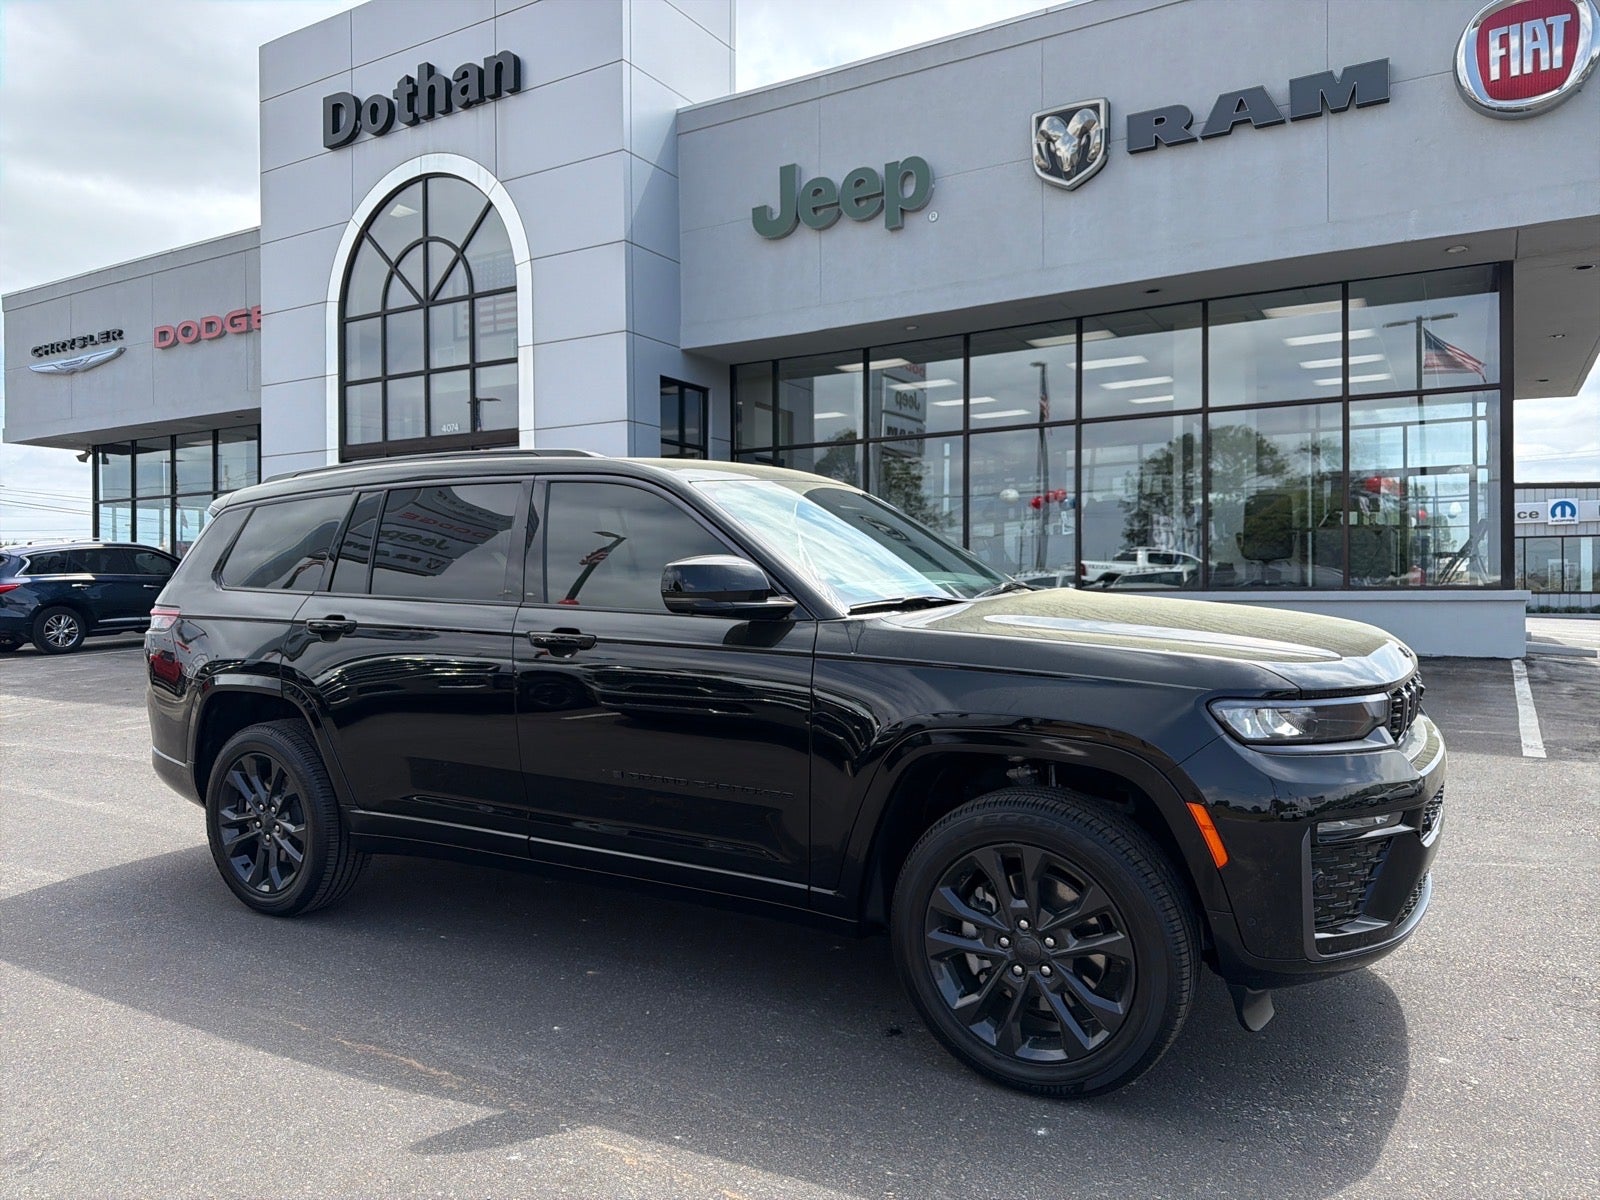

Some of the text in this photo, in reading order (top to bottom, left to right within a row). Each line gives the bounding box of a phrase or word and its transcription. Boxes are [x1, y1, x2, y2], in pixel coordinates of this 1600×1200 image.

[1488, 13, 1572, 82] FIAT
[322, 50, 521, 150] Dothan
[1126, 57, 1391, 154] RAM
[751, 155, 934, 240] Jeep
[31, 328, 124, 358] CHRYSLER
[441, 422, 459, 433] 4074
